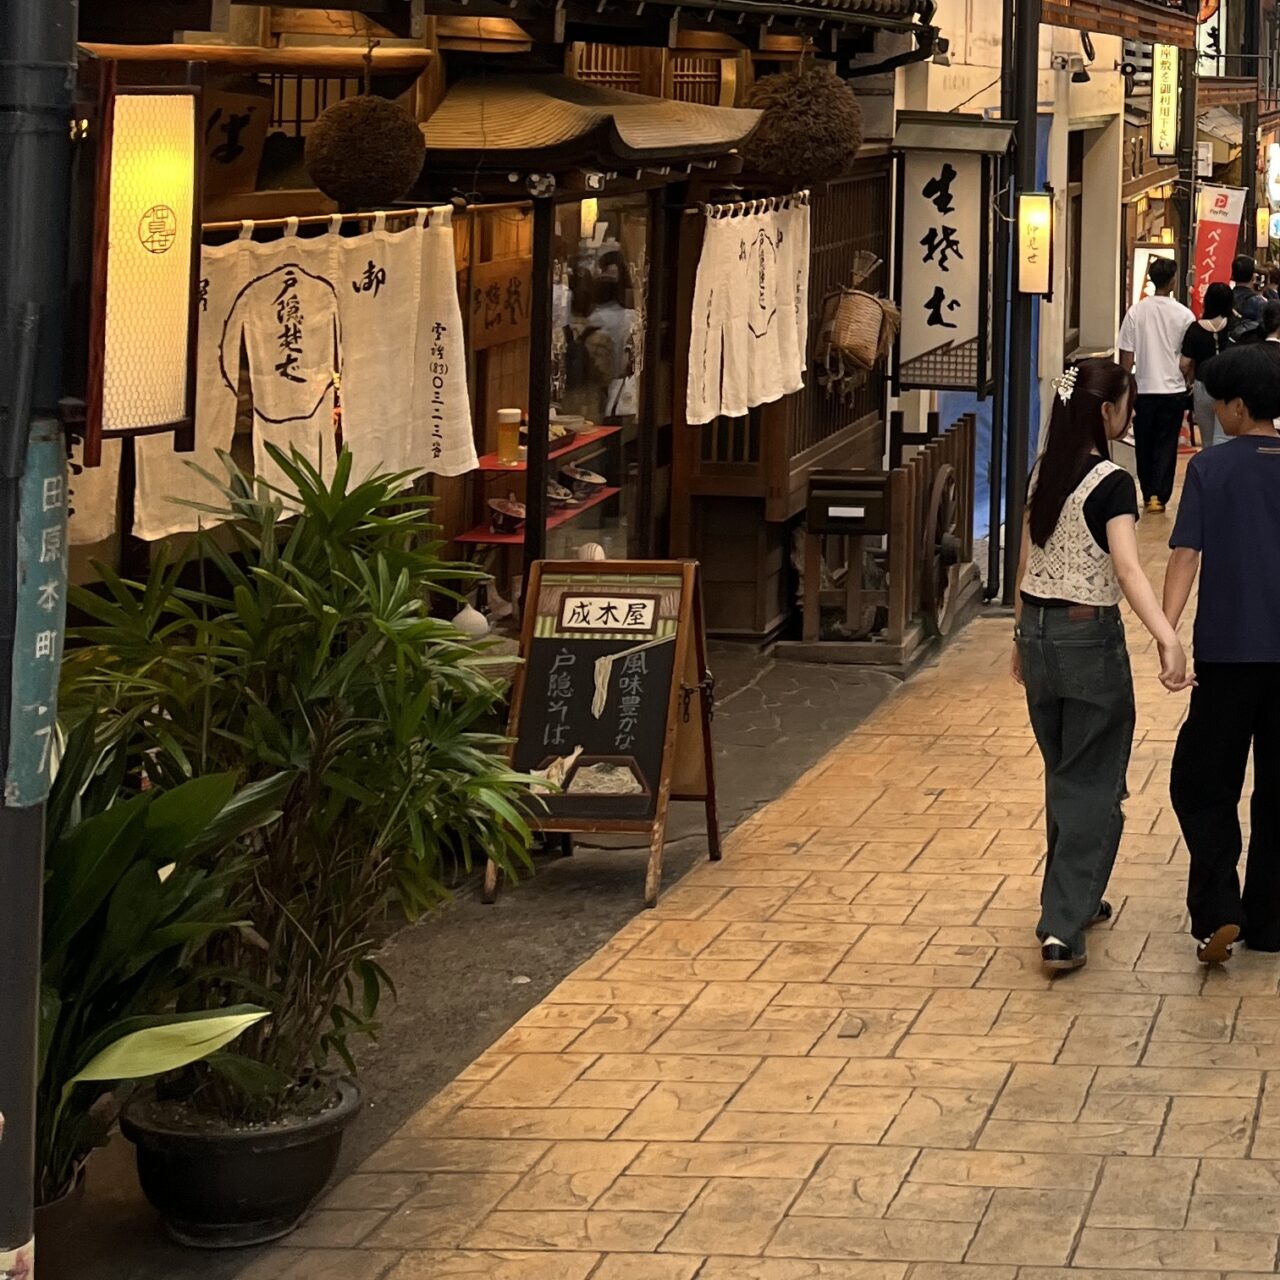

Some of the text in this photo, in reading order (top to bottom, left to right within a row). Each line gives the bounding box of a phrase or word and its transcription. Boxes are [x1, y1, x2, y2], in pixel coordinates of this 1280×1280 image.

[1159, 43, 1172, 151] 座敷を御利用下さい
[1209, 208, 1229, 217] PayPay
[35, 476, 63, 663] 田原本町
[567, 601, 648, 626] 成木屋
[543, 647, 577, 746] 戸隠そば
[614, 650, 649, 750] 風味豊かな
